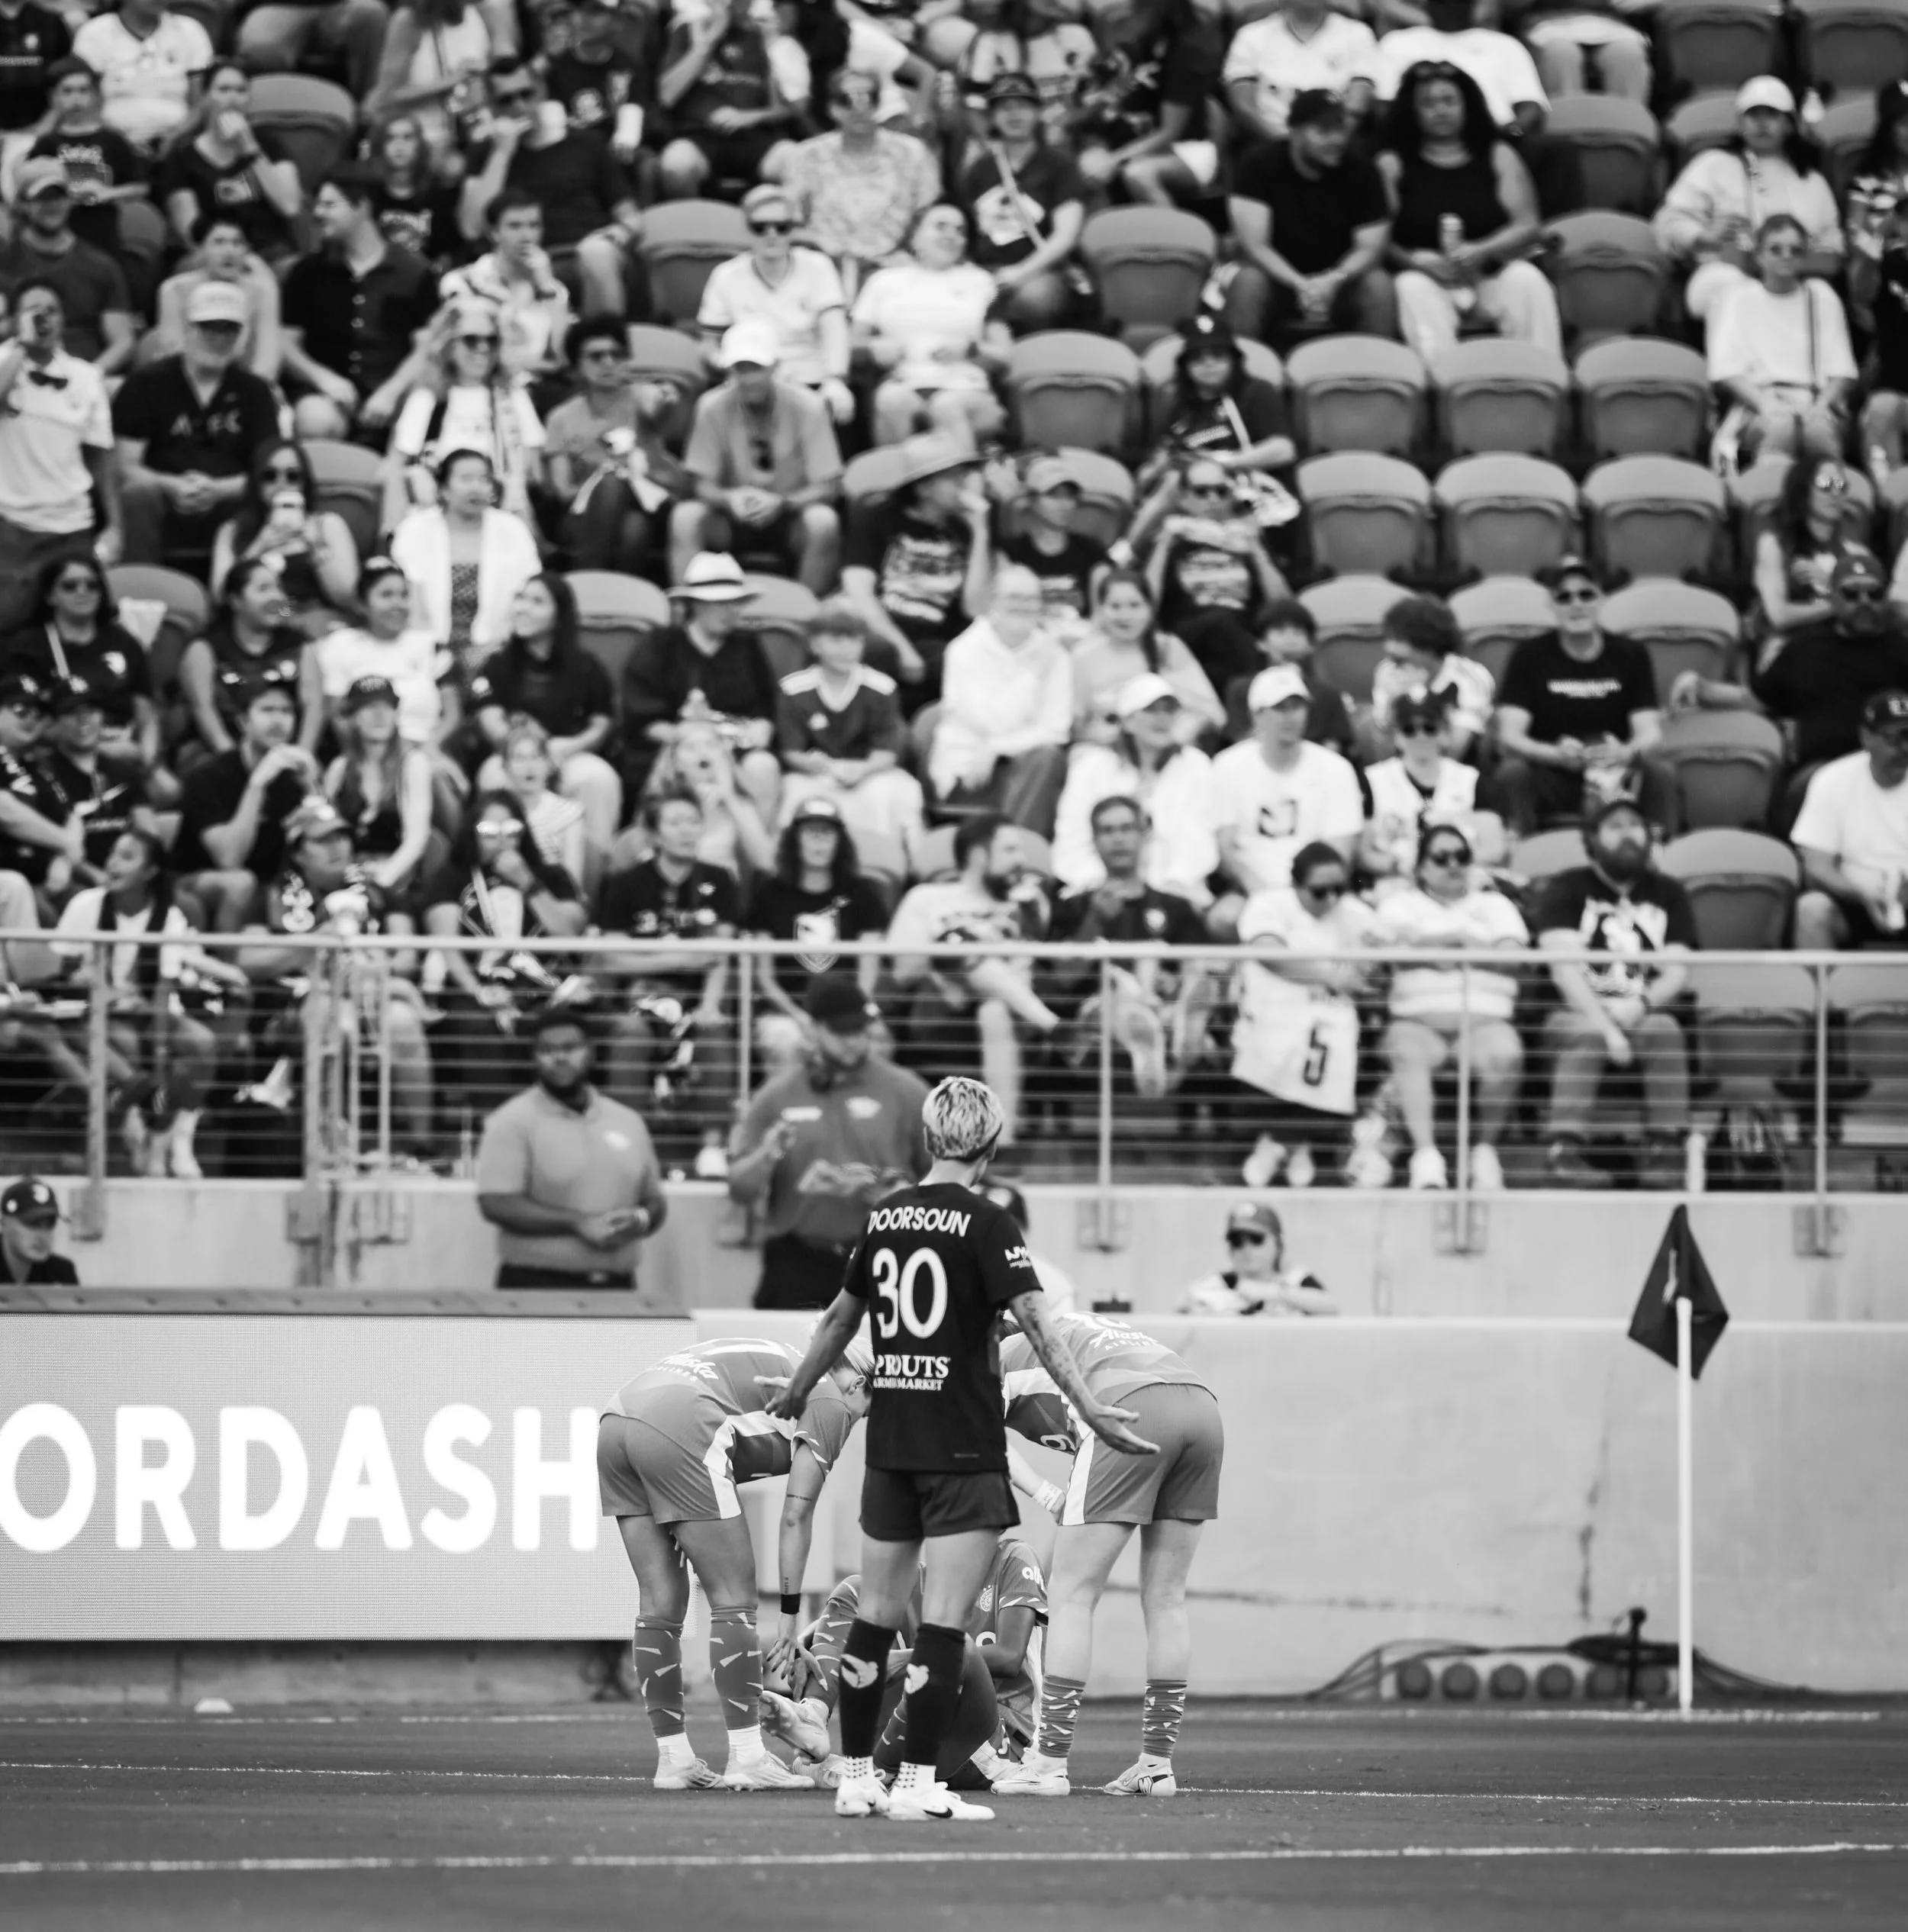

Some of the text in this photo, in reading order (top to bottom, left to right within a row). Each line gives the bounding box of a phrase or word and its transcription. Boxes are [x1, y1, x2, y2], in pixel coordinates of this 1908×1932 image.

[867, 1206, 972, 1238] DOORSOUN
[872, 1247, 948, 1339] 30
[0, 1402, 599, 1553] ORDASH
